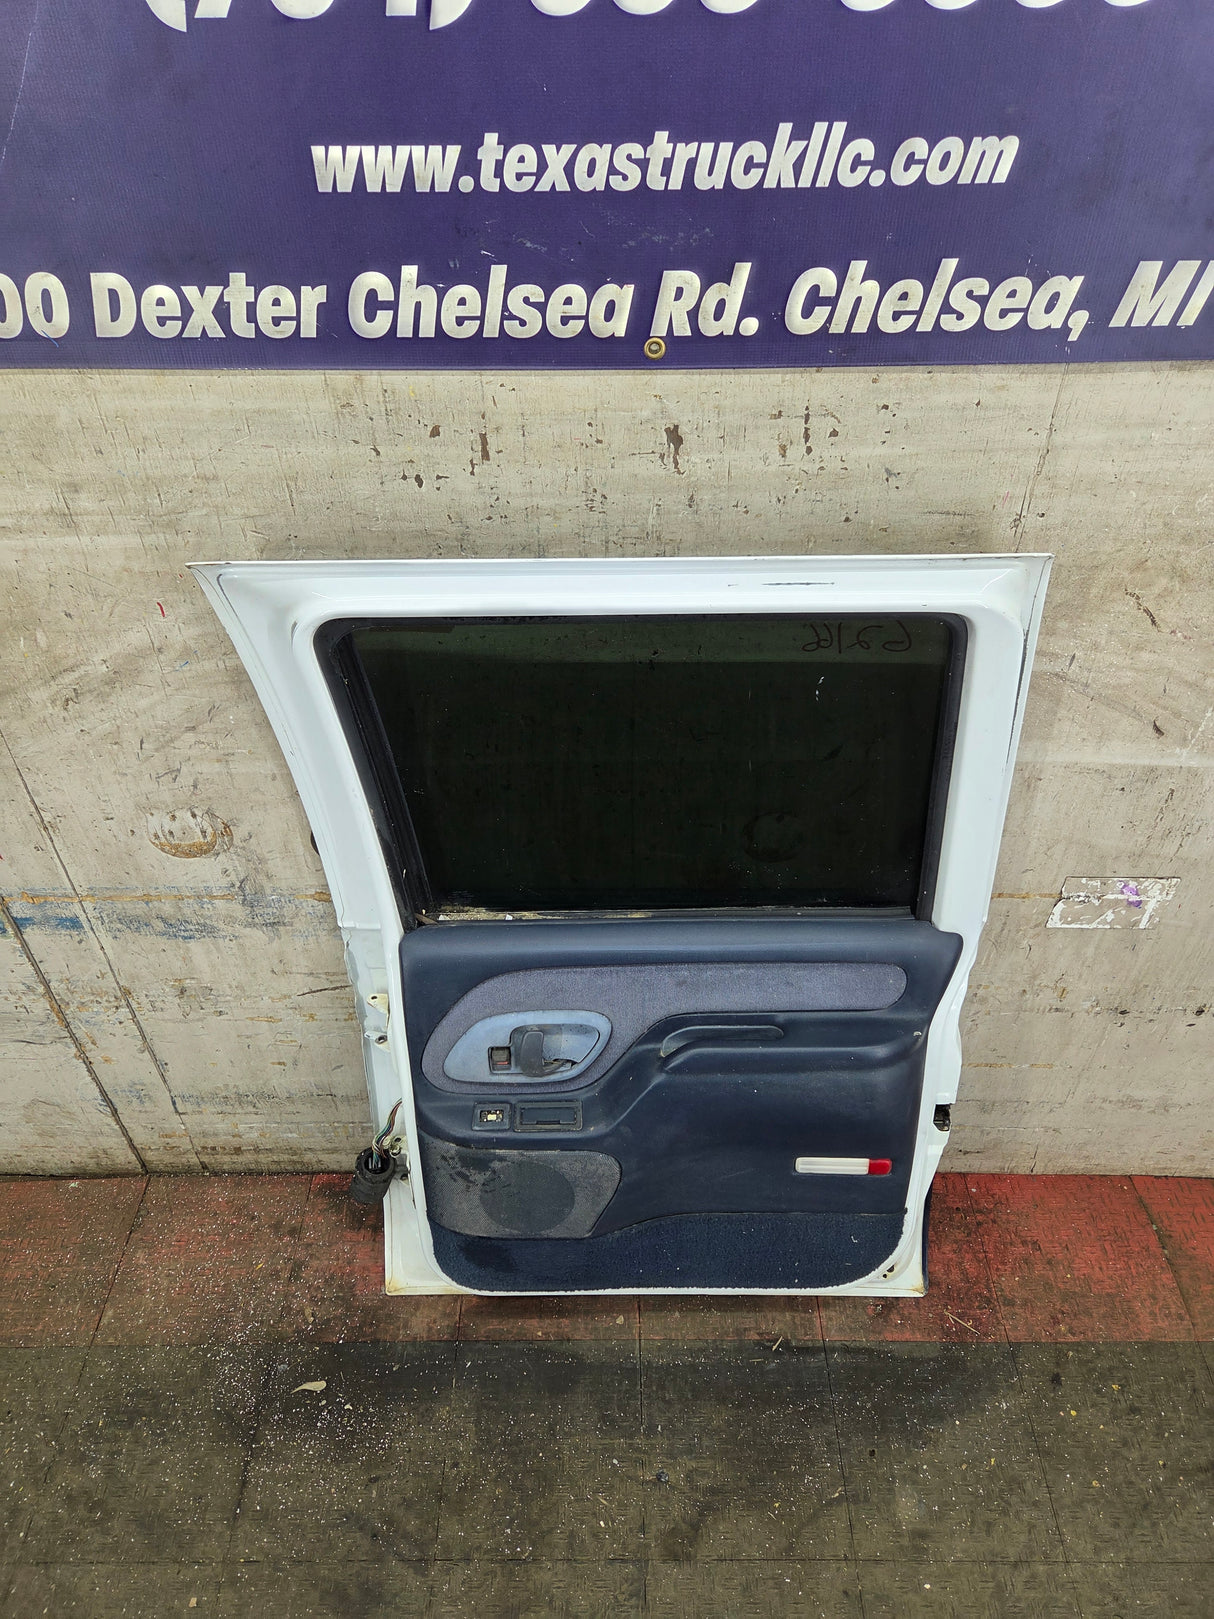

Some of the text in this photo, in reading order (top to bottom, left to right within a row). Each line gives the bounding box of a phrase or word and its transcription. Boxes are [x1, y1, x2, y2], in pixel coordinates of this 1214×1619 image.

[310, 121, 1020, 194] www.texastruckllc.com
[89, 271, 328, 339] Dexter
[347, 263, 635, 339] Chelsea
[649, 261, 760, 338] Rd.
[784, 257, 1090, 342] Chelsea,
[1108, 259, 1214, 329] MI
